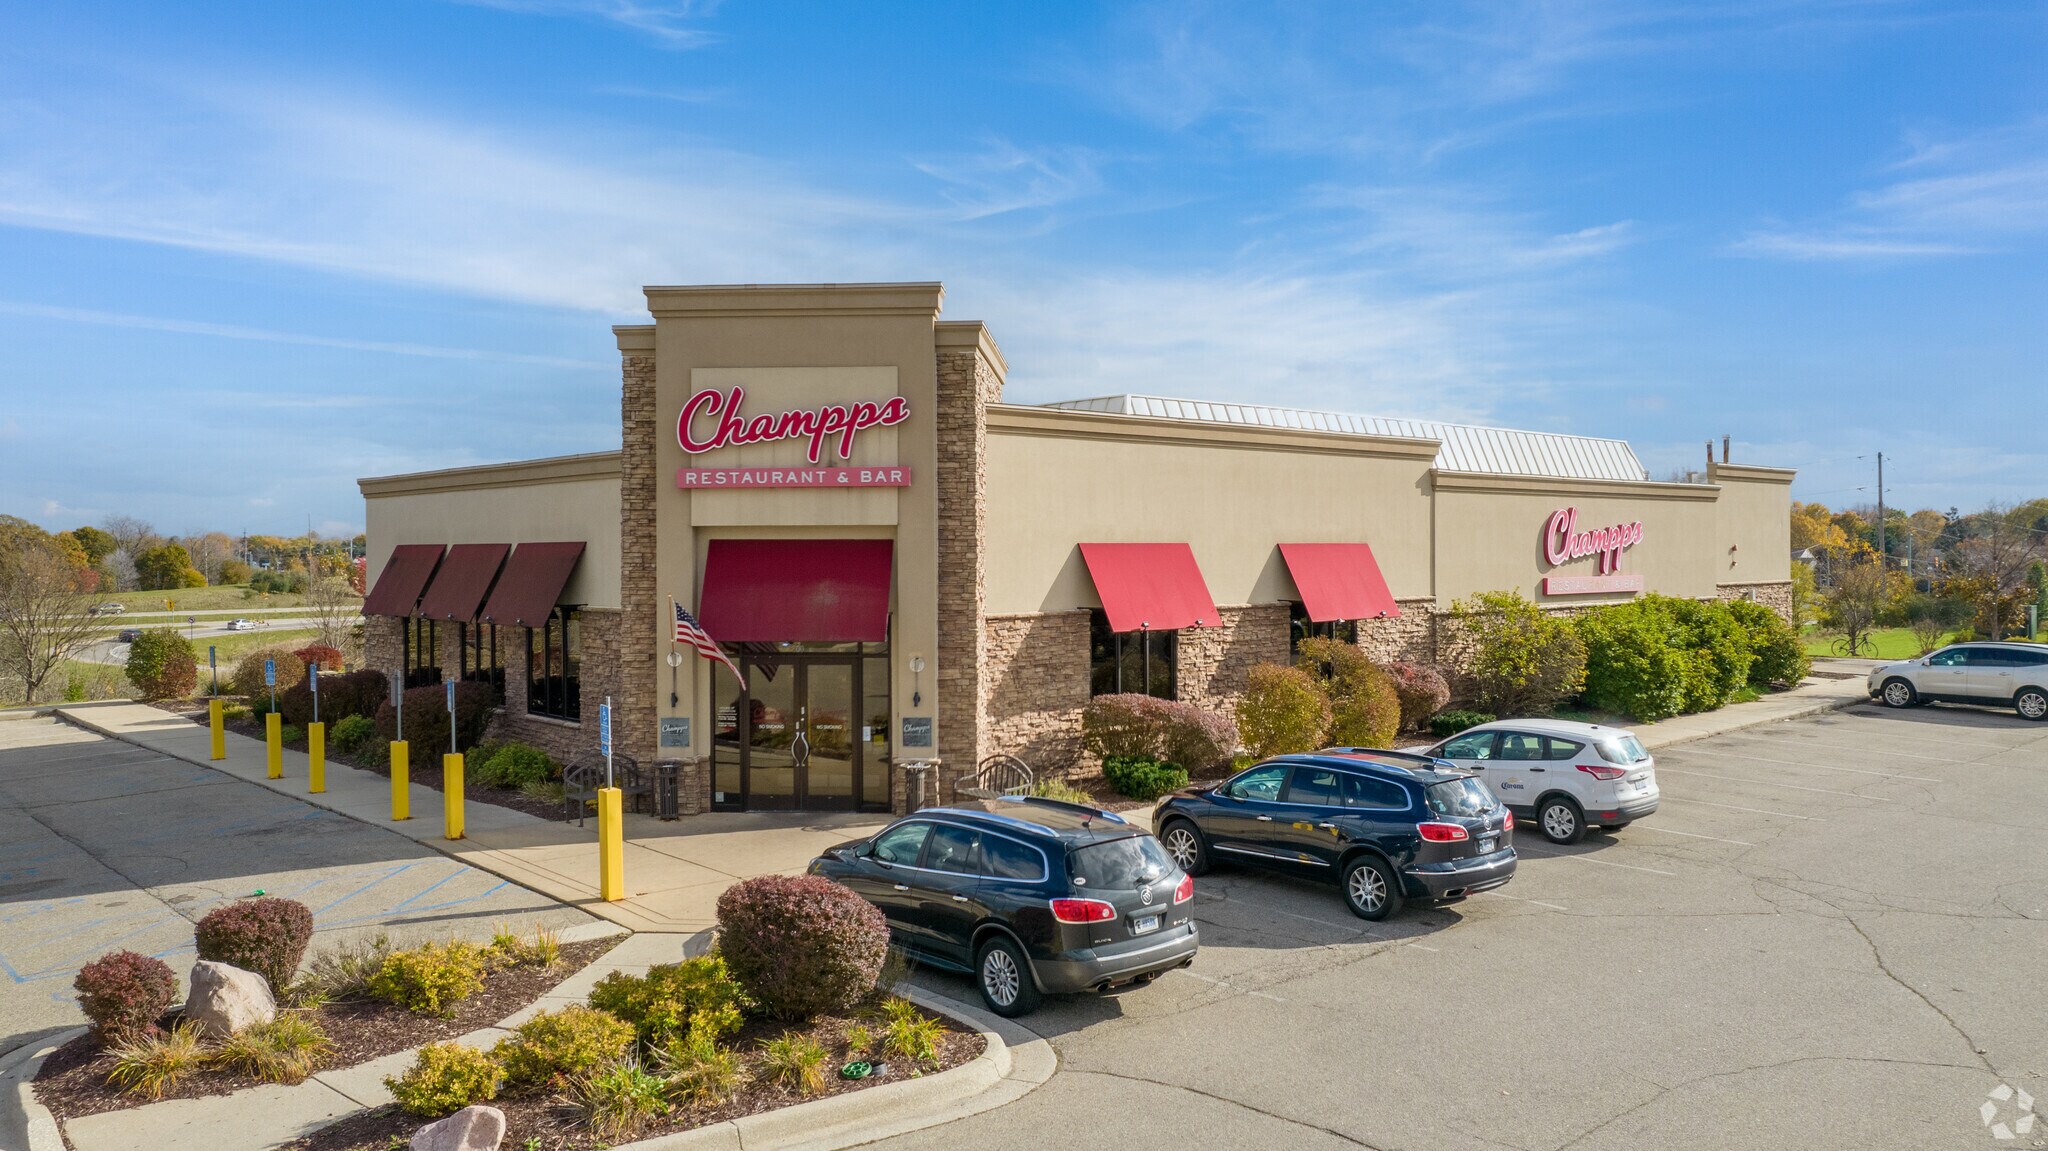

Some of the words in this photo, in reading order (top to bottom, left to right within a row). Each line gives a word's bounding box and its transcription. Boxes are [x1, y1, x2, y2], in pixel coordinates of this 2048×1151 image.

[677, 385, 910, 463] Champps
[685, 471, 826, 485] RESTAURANT
[837, 472, 849, 483] &
[860, 470, 902, 483] BAR
[1543, 507, 1644, 575] Champps
[1501, 782, 1524, 790] Corona
